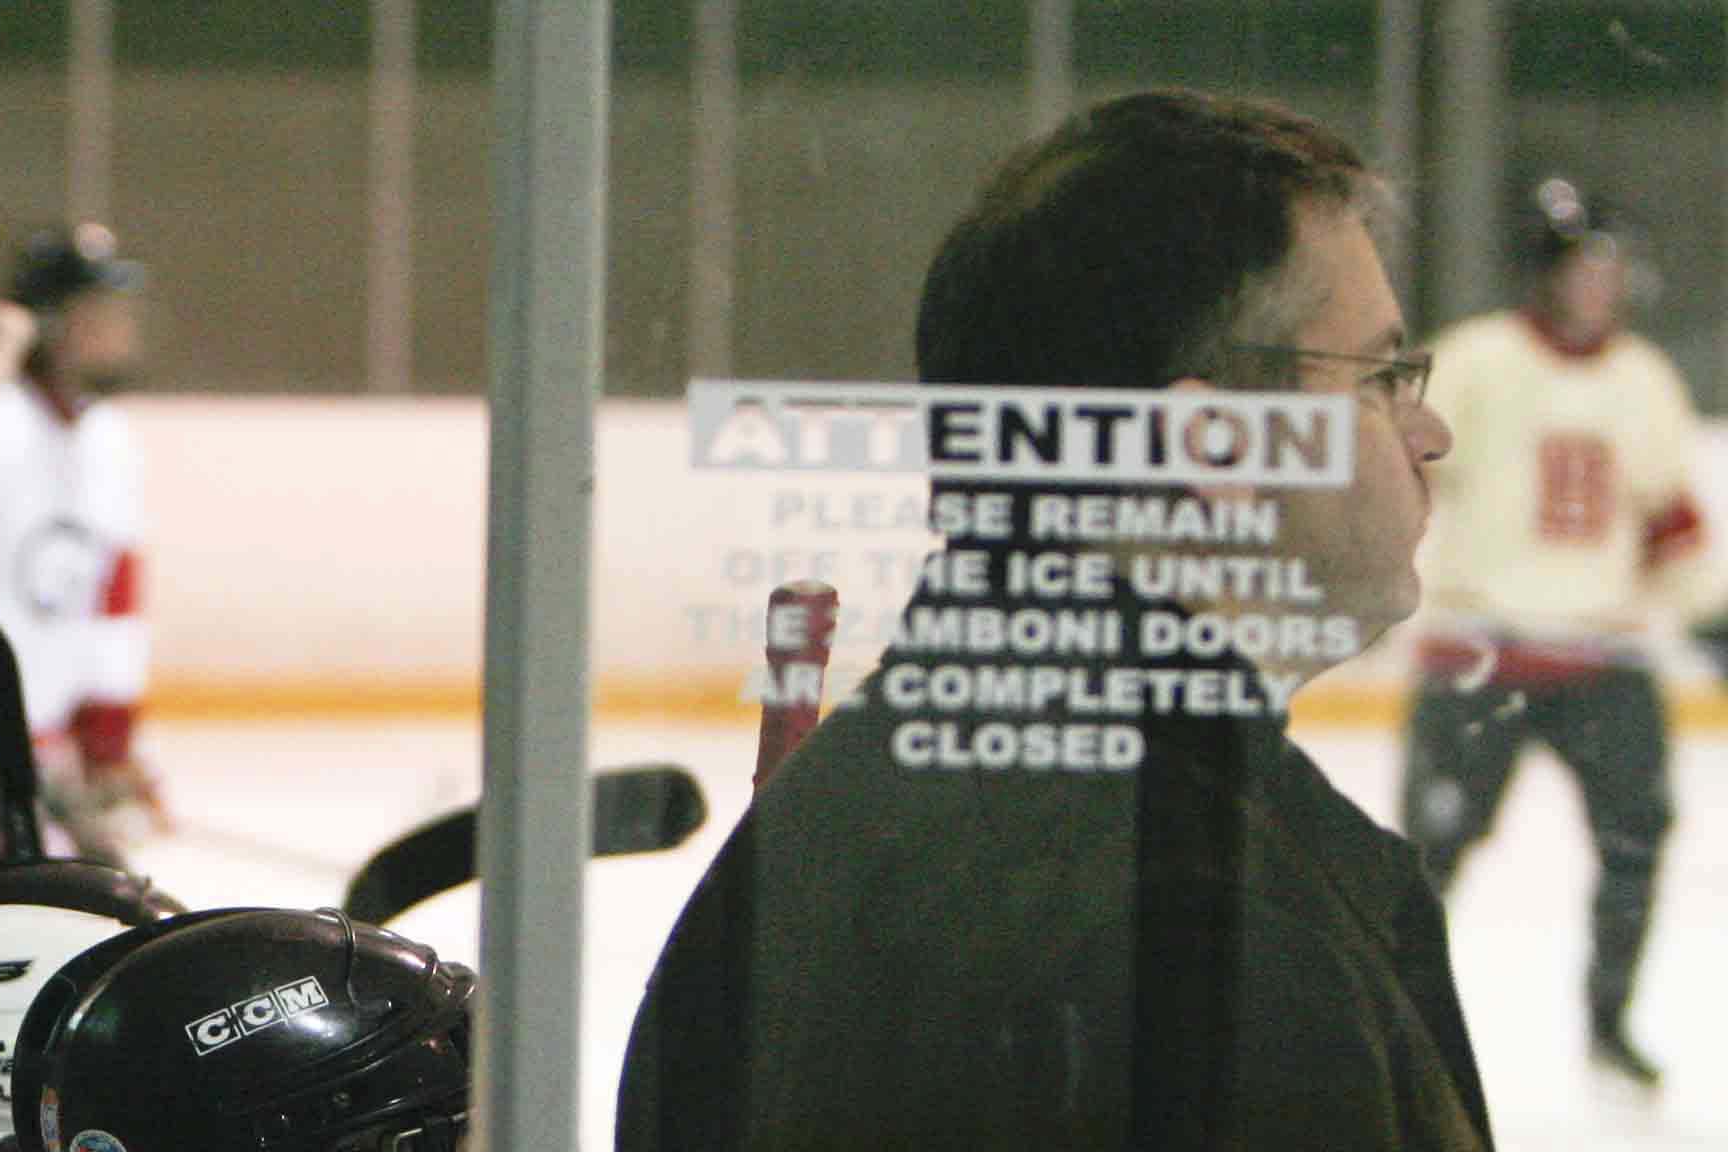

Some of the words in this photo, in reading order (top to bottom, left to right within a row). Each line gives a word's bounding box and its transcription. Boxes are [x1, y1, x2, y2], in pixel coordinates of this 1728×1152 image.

[708, 399, 1329, 470] ATTENTION
[772, 492, 1012, 540] PLEASE
[1030, 494, 1277, 544] REMAIN
[723, 550, 840, 590] OFF
[866, 550, 990, 596] THE
[1007, 552, 1114, 597] ICE
[1131, 554, 1323, 600] UNTIL
[687, 605, 810, 650] THE
[824, 606, 1122, 655] ZAMBONI
[1140, 611, 1359, 658] DOORS
[882, 663, 1300, 715] COMPLETELY
[891, 721, 1146, 770] CLOSED
[186, 976, 329, 1056] CCM
